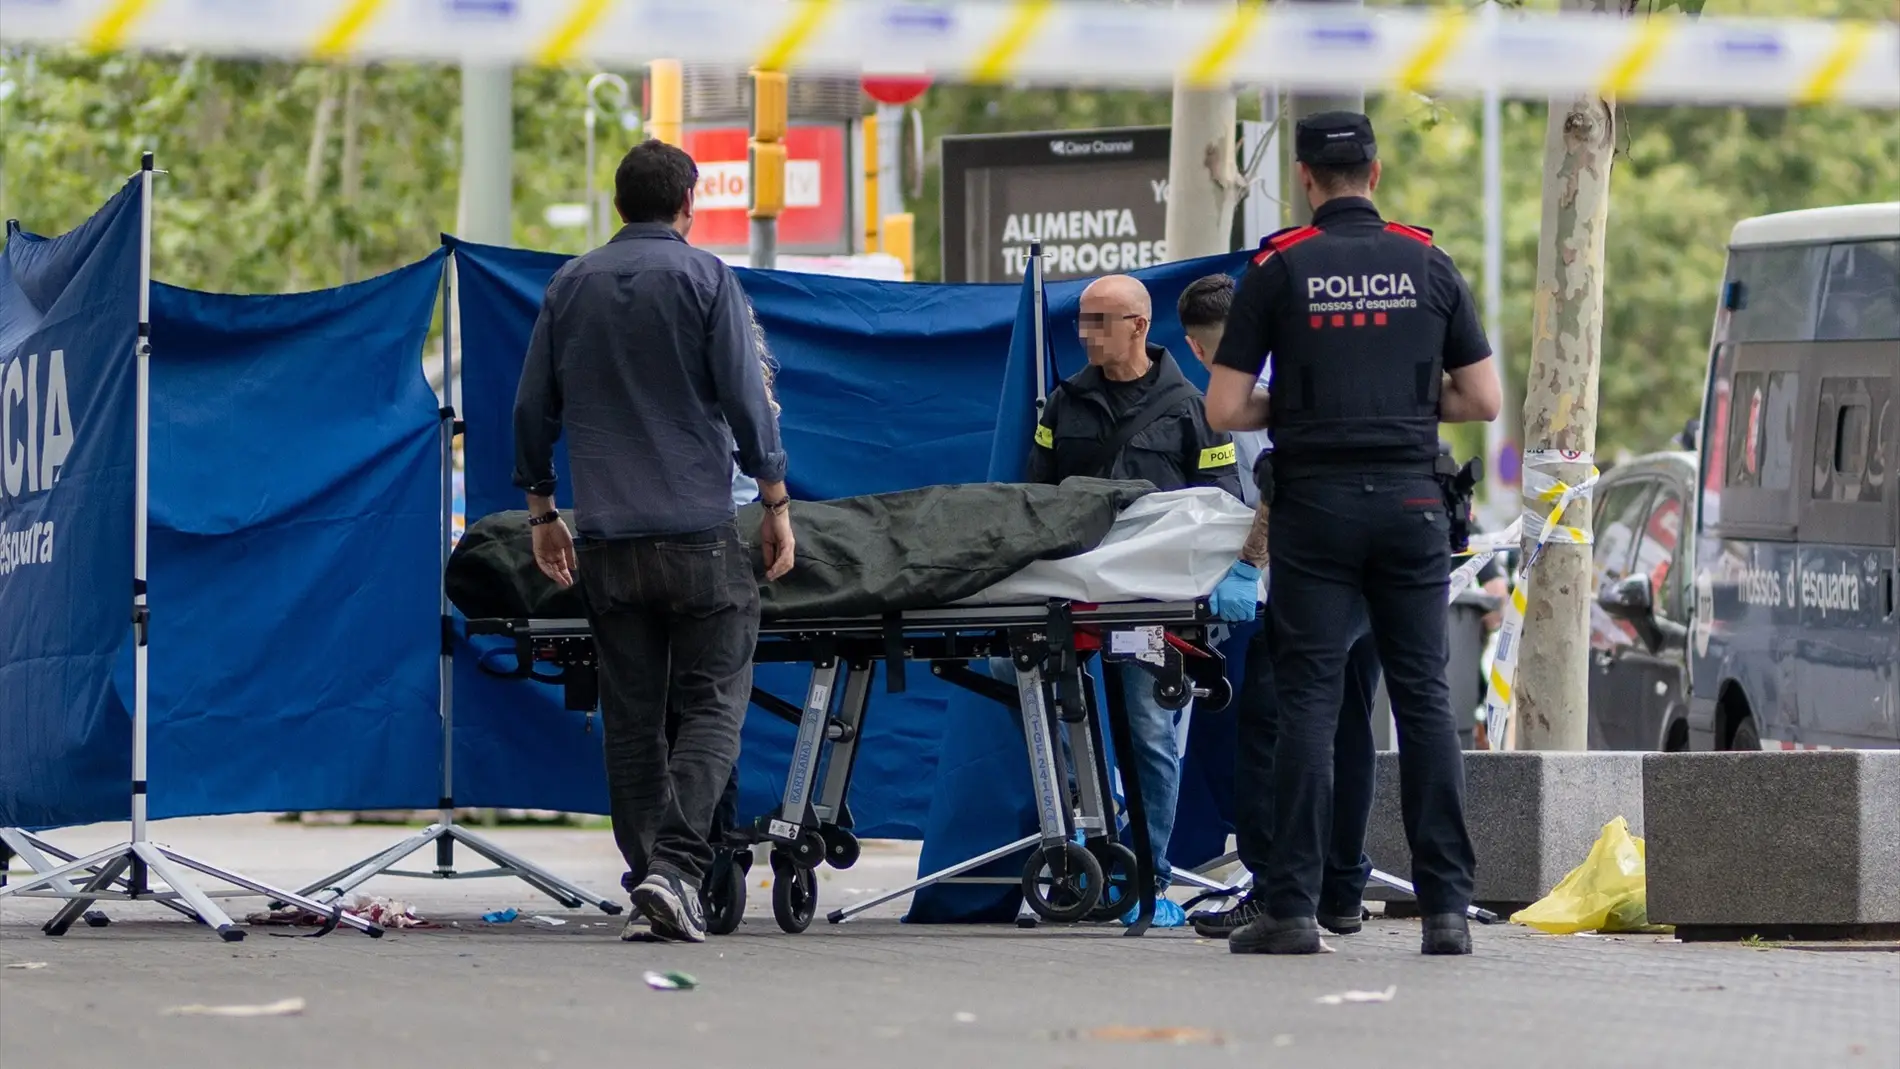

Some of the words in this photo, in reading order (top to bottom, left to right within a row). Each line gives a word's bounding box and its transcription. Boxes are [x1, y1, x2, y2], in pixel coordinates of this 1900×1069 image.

[1065, 141, 1091, 155] Clear
[1092, 139, 1134, 153] Channel
[1002, 209, 1137, 242] ALIMENTA
[1307, 273, 1416, 298] POLICIA
[1309, 301, 1353, 312] mossos
[1356, 297, 1417, 310] d'esquadra
[0, 349, 74, 498] CIA
[1738, 567, 1781, 607] mossos
